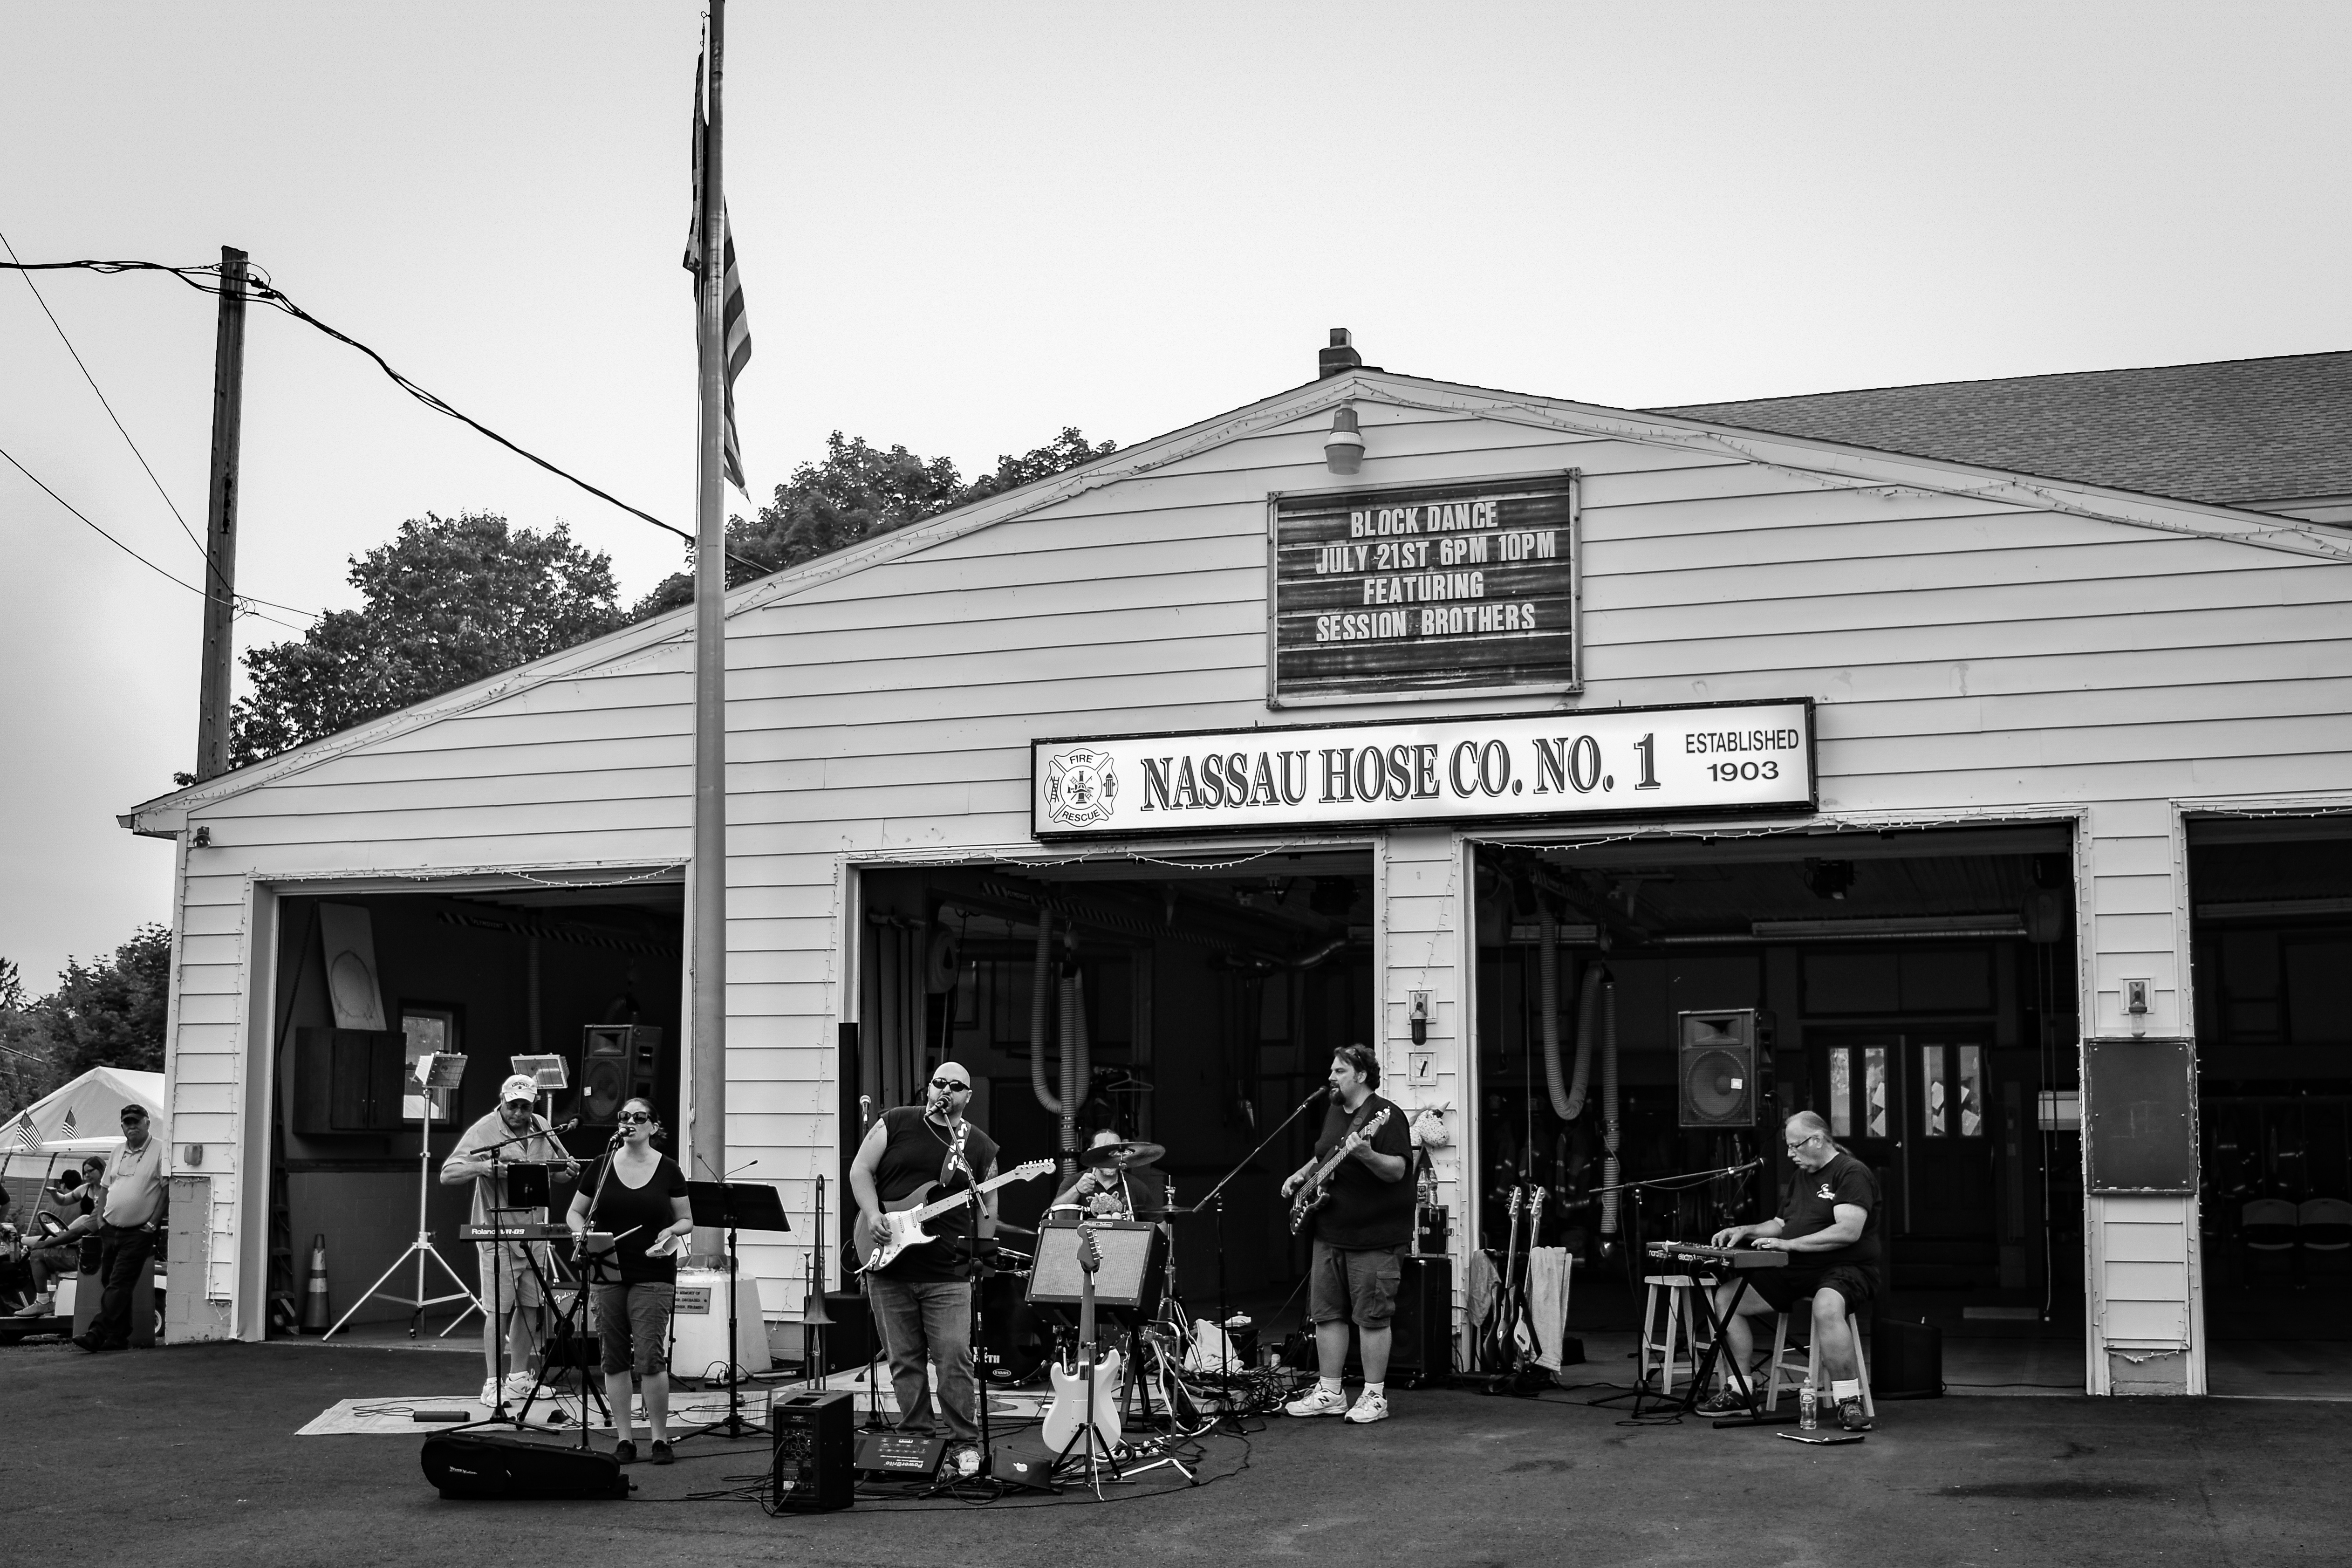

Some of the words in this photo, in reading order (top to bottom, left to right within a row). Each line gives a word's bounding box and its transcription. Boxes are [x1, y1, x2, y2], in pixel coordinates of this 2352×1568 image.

[1351, 507, 1419, 538] BLOCK
[1427, 502, 1497, 532] DANCE
[1316, 546, 1368, 574] JULY
[1377, 541, 1429, 570] 21ST
[1440, 537, 1487, 565] 6PM
[1499, 532, 1556, 561] 10PM
[1363, 572, 1484, 605] FEATURING
[1316, 611, 1406, 642] SESSION
[1422, 604, 1535, 636] BROTHERS
[1685, 729, 1799, 754] ESTABLISHED
[1069, 754, 1094, 764] FIRE
[1141, 750, 1311, 811] NASSAU
[1319, 744, 1440, 804] HOSE
[1449, 739, 1523, 798] CO.
[1533, 735, 1614, 794] NO.
[1634, 733, 1661, 790] 1
[1707, 760, 1779, 782] 1903
[1062, 809, 1100, 822] RESCUE
